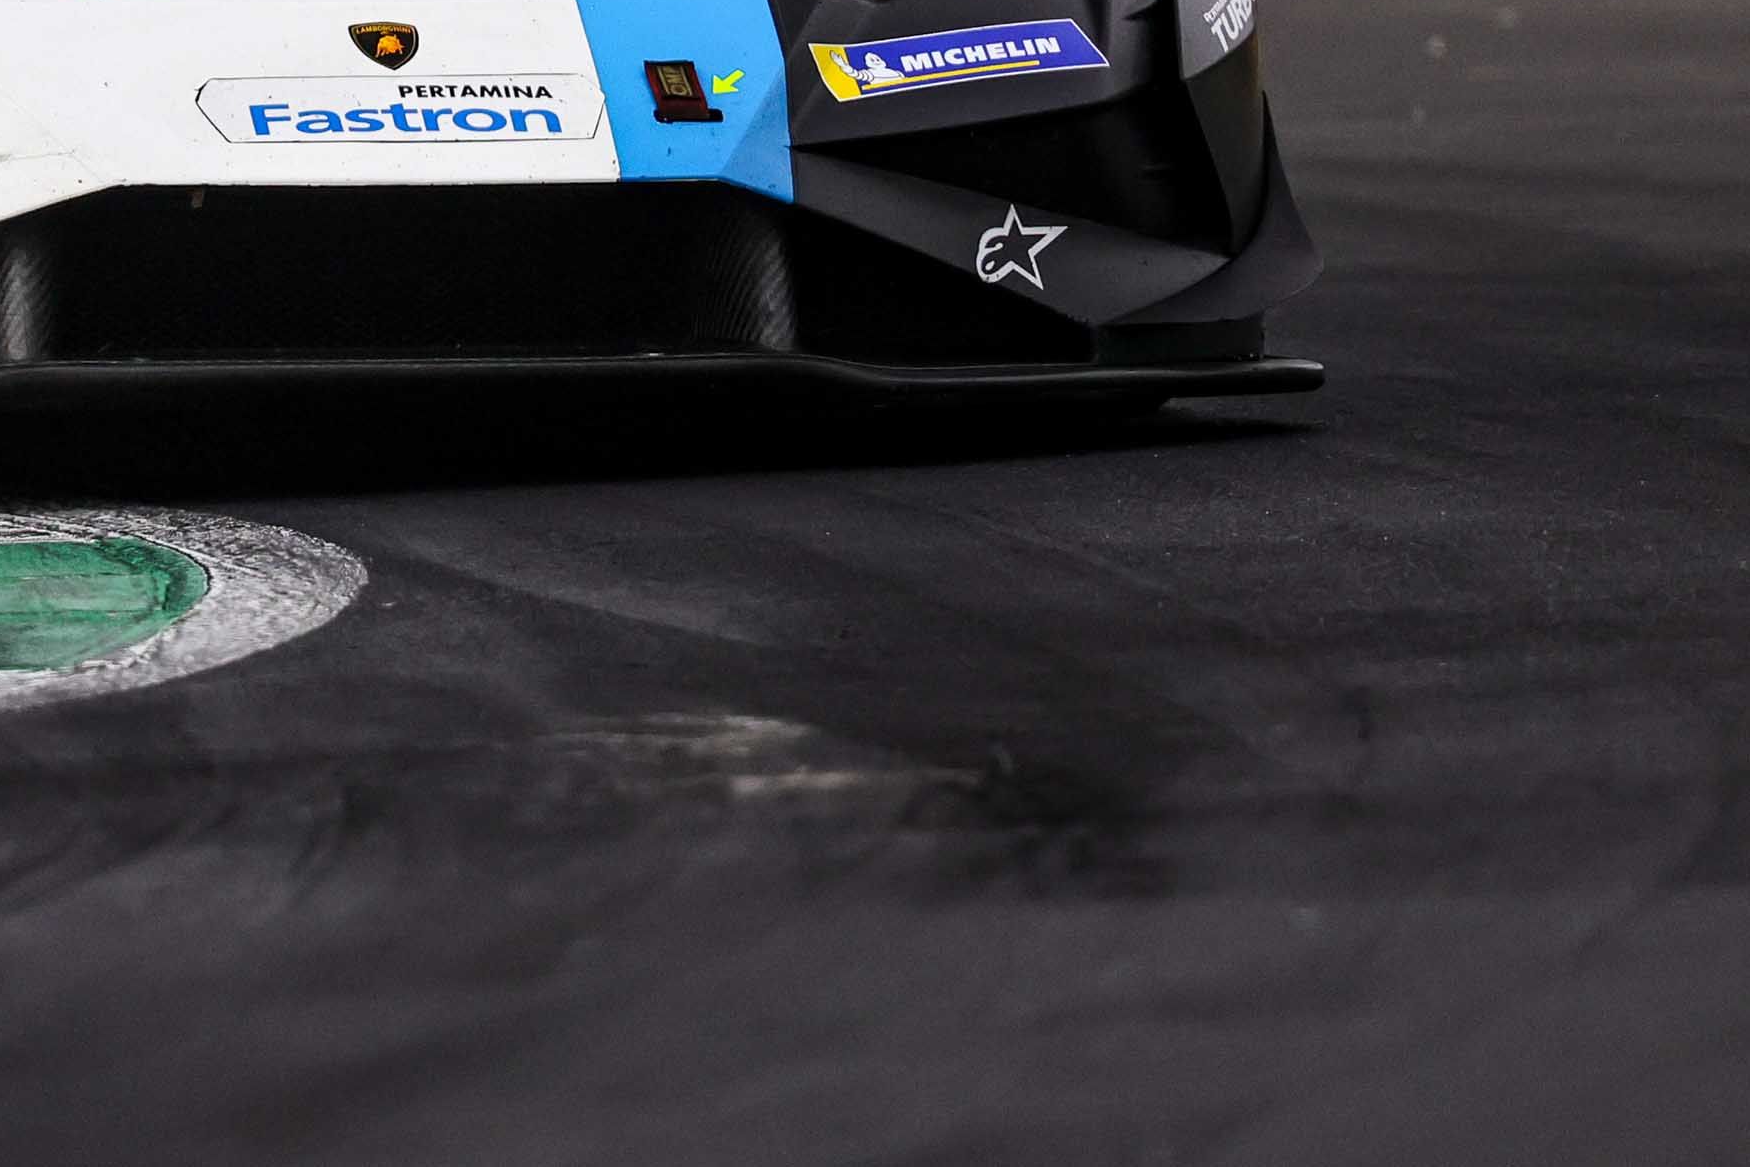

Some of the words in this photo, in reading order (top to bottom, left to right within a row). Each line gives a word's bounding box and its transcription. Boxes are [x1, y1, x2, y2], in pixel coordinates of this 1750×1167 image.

[900, 36, 1061, 72] MICHELIN
[399, 85, 553, 99] PERTAMINA
[250, 104, 561, 134] Fastron
